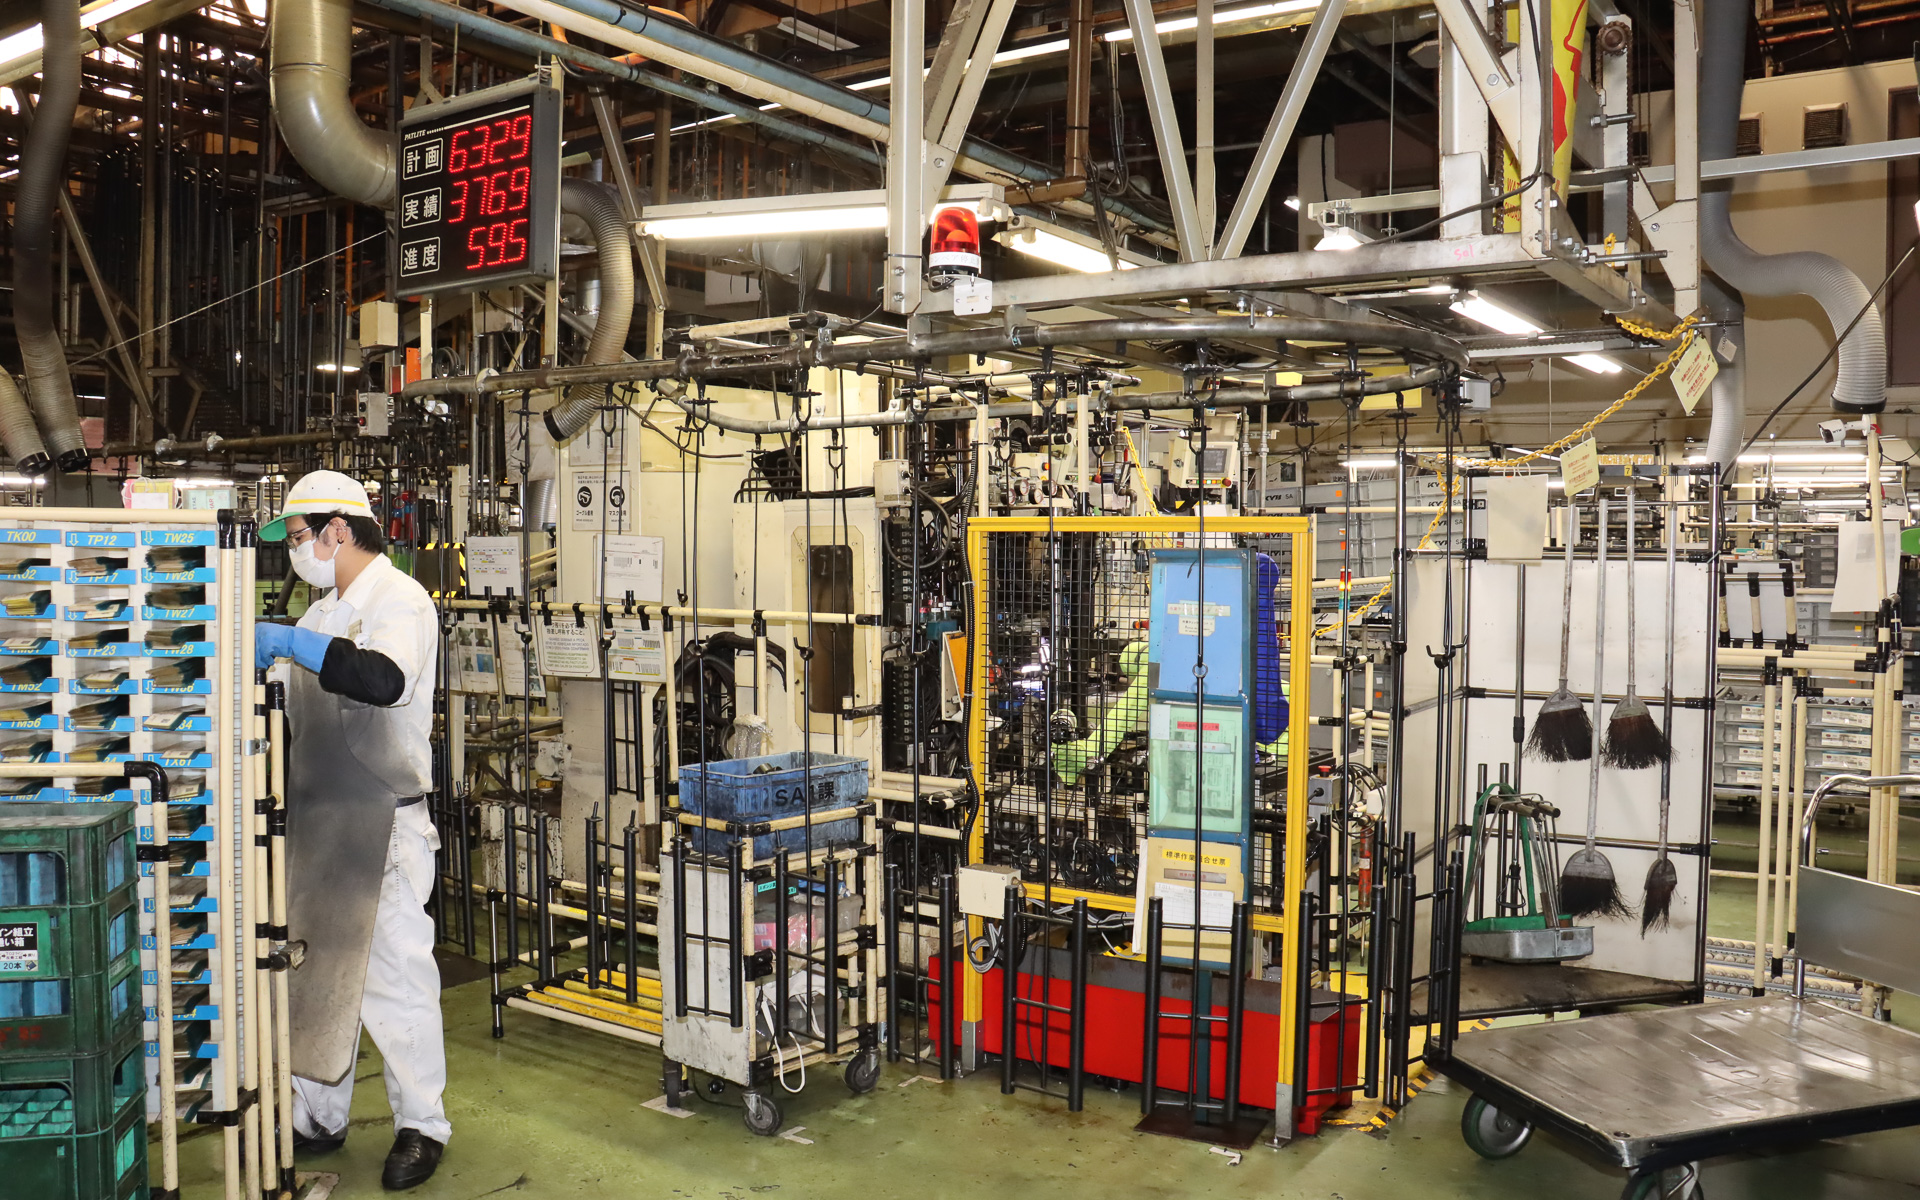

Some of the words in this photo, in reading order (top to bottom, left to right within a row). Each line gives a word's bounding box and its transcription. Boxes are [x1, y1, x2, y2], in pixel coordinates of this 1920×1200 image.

[404, 129, 427, 141] PATLITE
[448, 114, 532, 174] 6329
[406, 144, 441, 174] 計画
[448, 166, 531, 223] 3769
[404, 193, 439, 223] 実績
[403, 243, 437, 270] 進度
[6, 531, 37, 542] TK00
[88, 535, 117, 545] TP12
[164, 533, 195, 543] TW25
[165, 570, 195, 580] TW26
[165, 608, 196, 618] TW27
[3, 962, 22, 970] 20本
